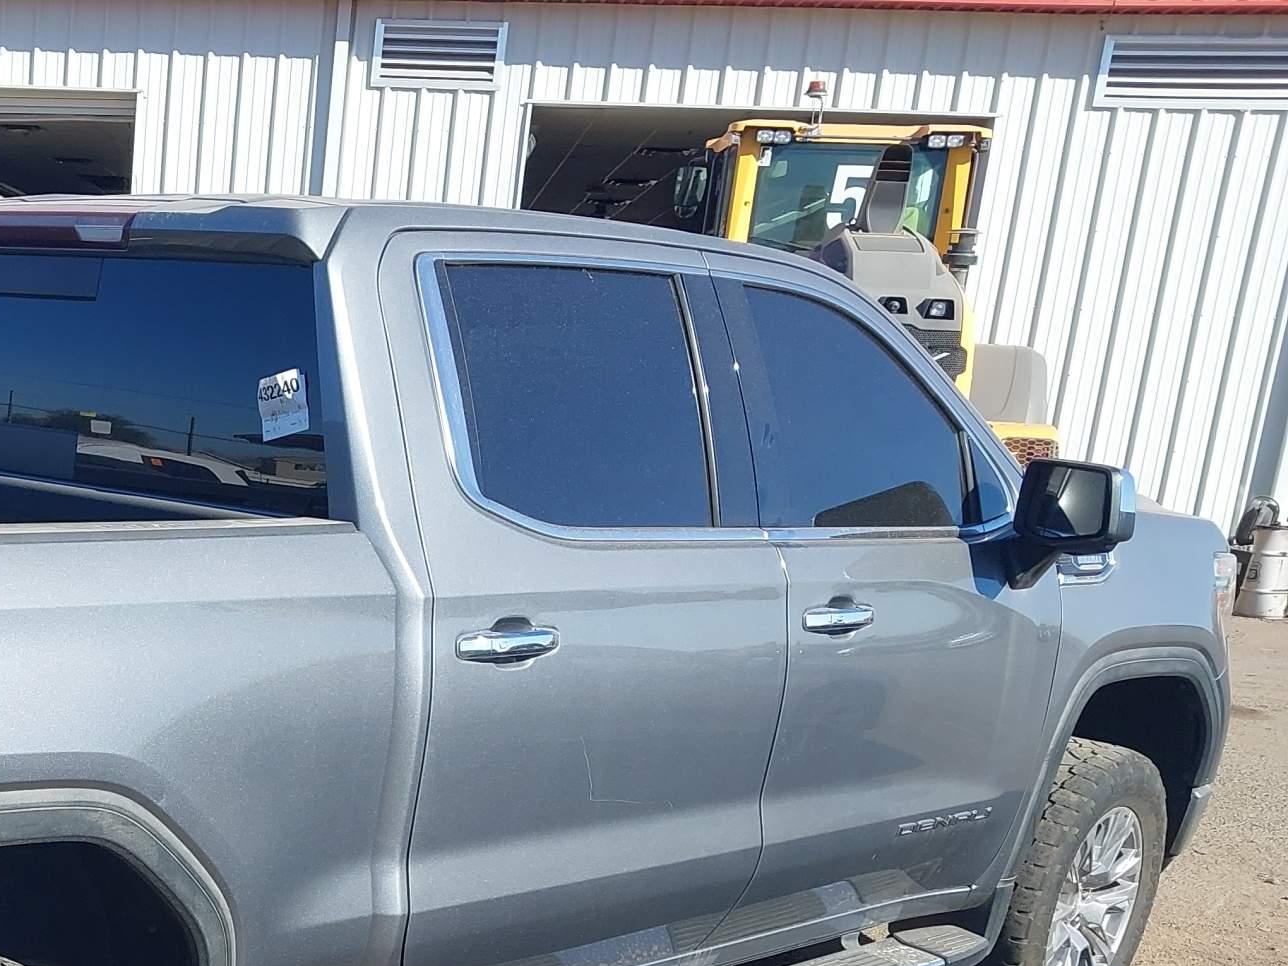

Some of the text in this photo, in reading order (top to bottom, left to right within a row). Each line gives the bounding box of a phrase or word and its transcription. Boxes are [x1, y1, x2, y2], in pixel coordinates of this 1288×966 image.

[826, 164, 875, 230] 5
[258, 377, 300, 402] 432240
[895, 806, 993, 837] DENALI
